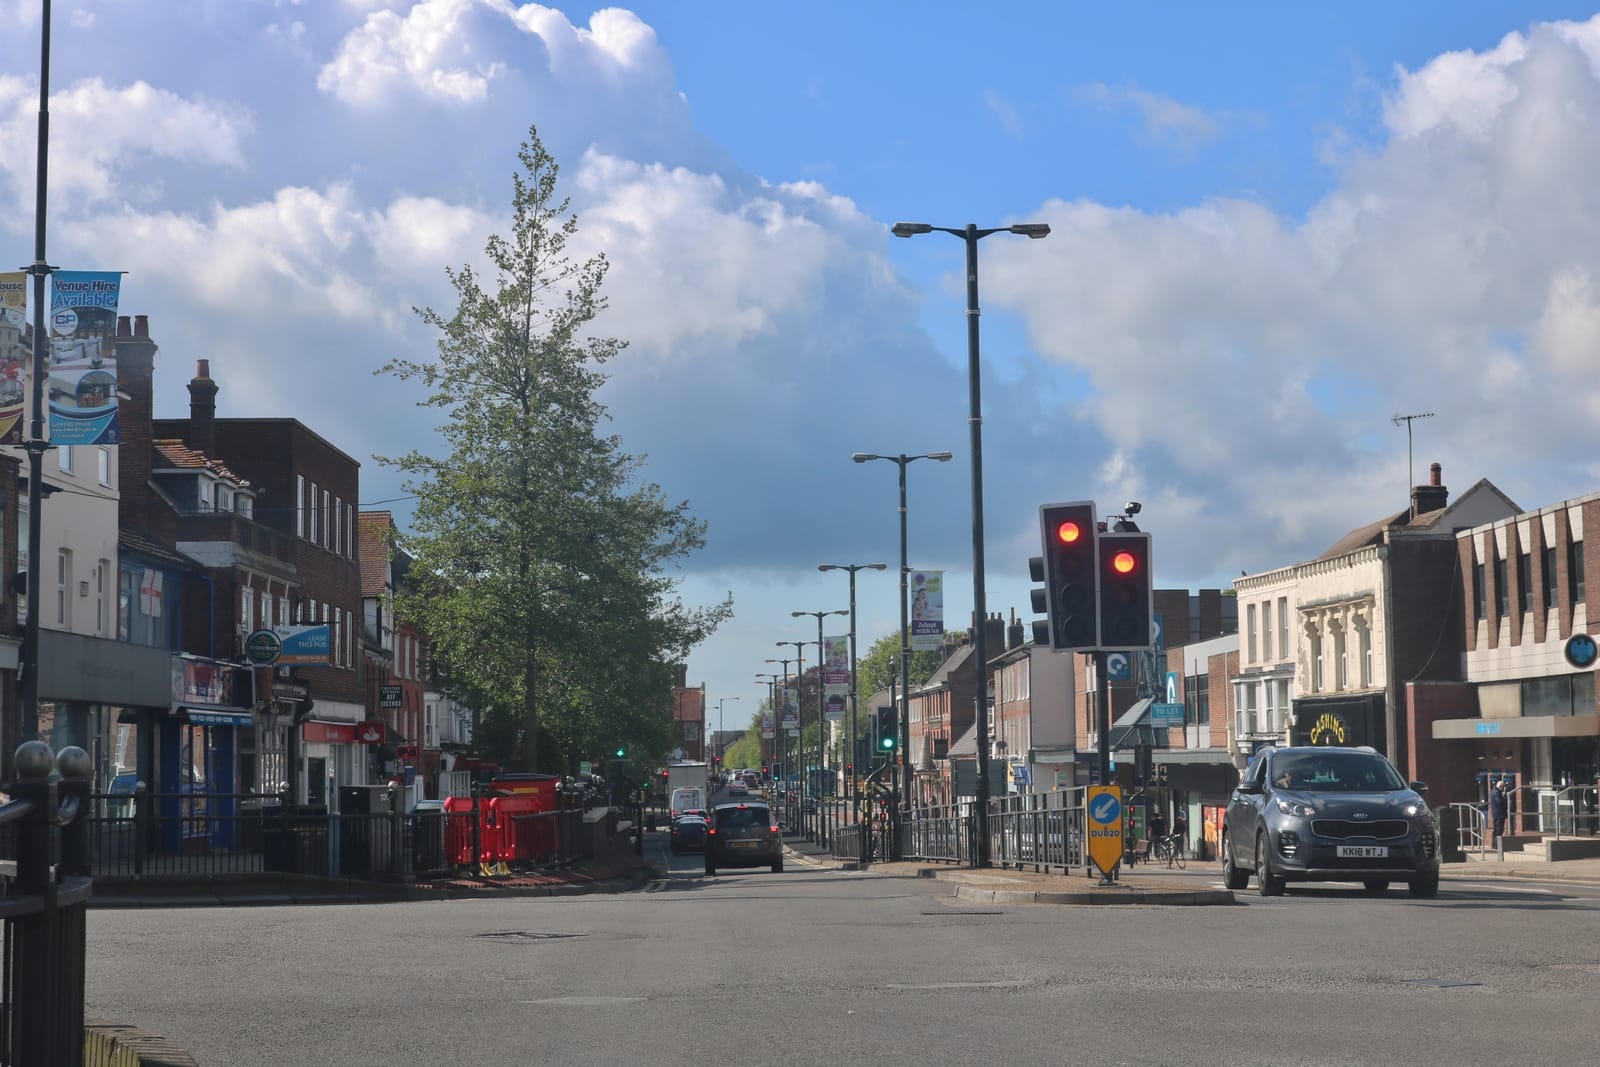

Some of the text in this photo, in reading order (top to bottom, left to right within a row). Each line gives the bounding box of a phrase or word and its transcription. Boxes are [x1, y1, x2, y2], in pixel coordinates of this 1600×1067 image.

[55, 280, 117, 292] Venue Hire
[55, 292, 115, 306] Available
[1311, 713, 1344, 744] CASHINO
